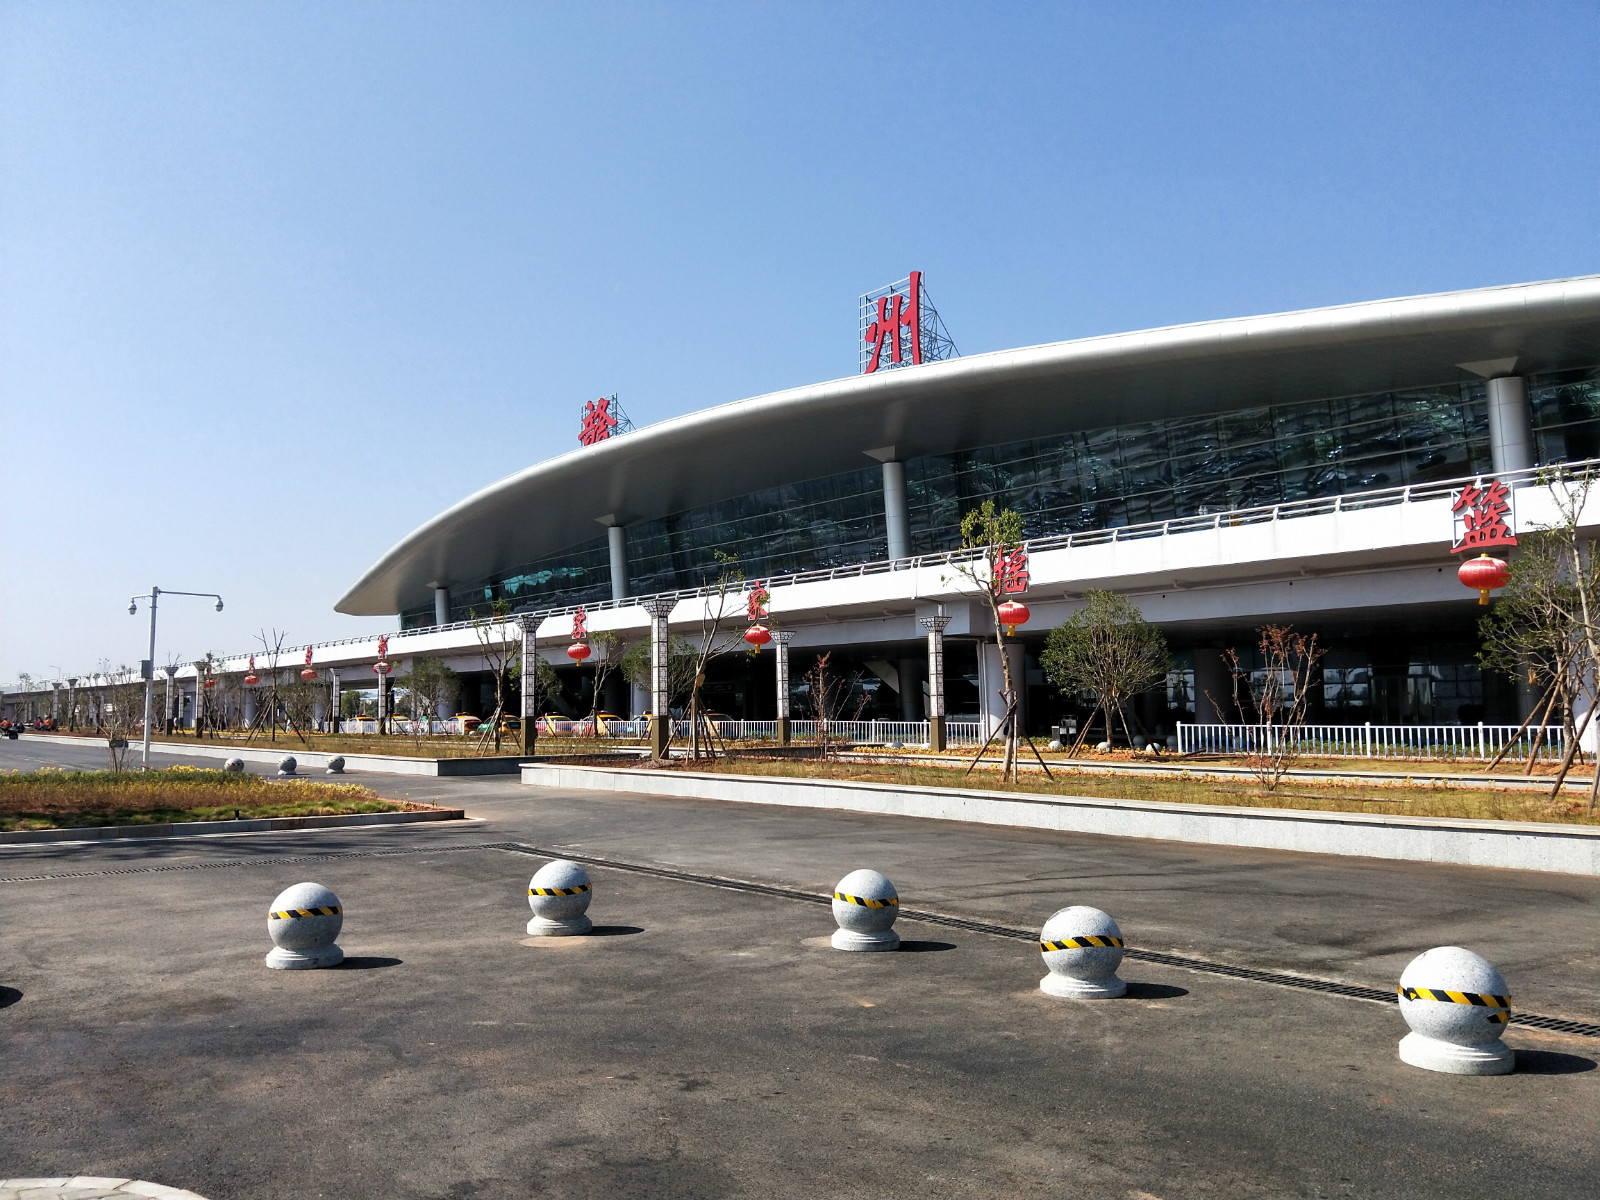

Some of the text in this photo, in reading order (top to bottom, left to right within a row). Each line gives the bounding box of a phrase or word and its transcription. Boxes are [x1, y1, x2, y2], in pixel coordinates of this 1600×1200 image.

[864, 271, 921, 375] 州
[570, 481, 1519, 639] 客 家 摇 篮
